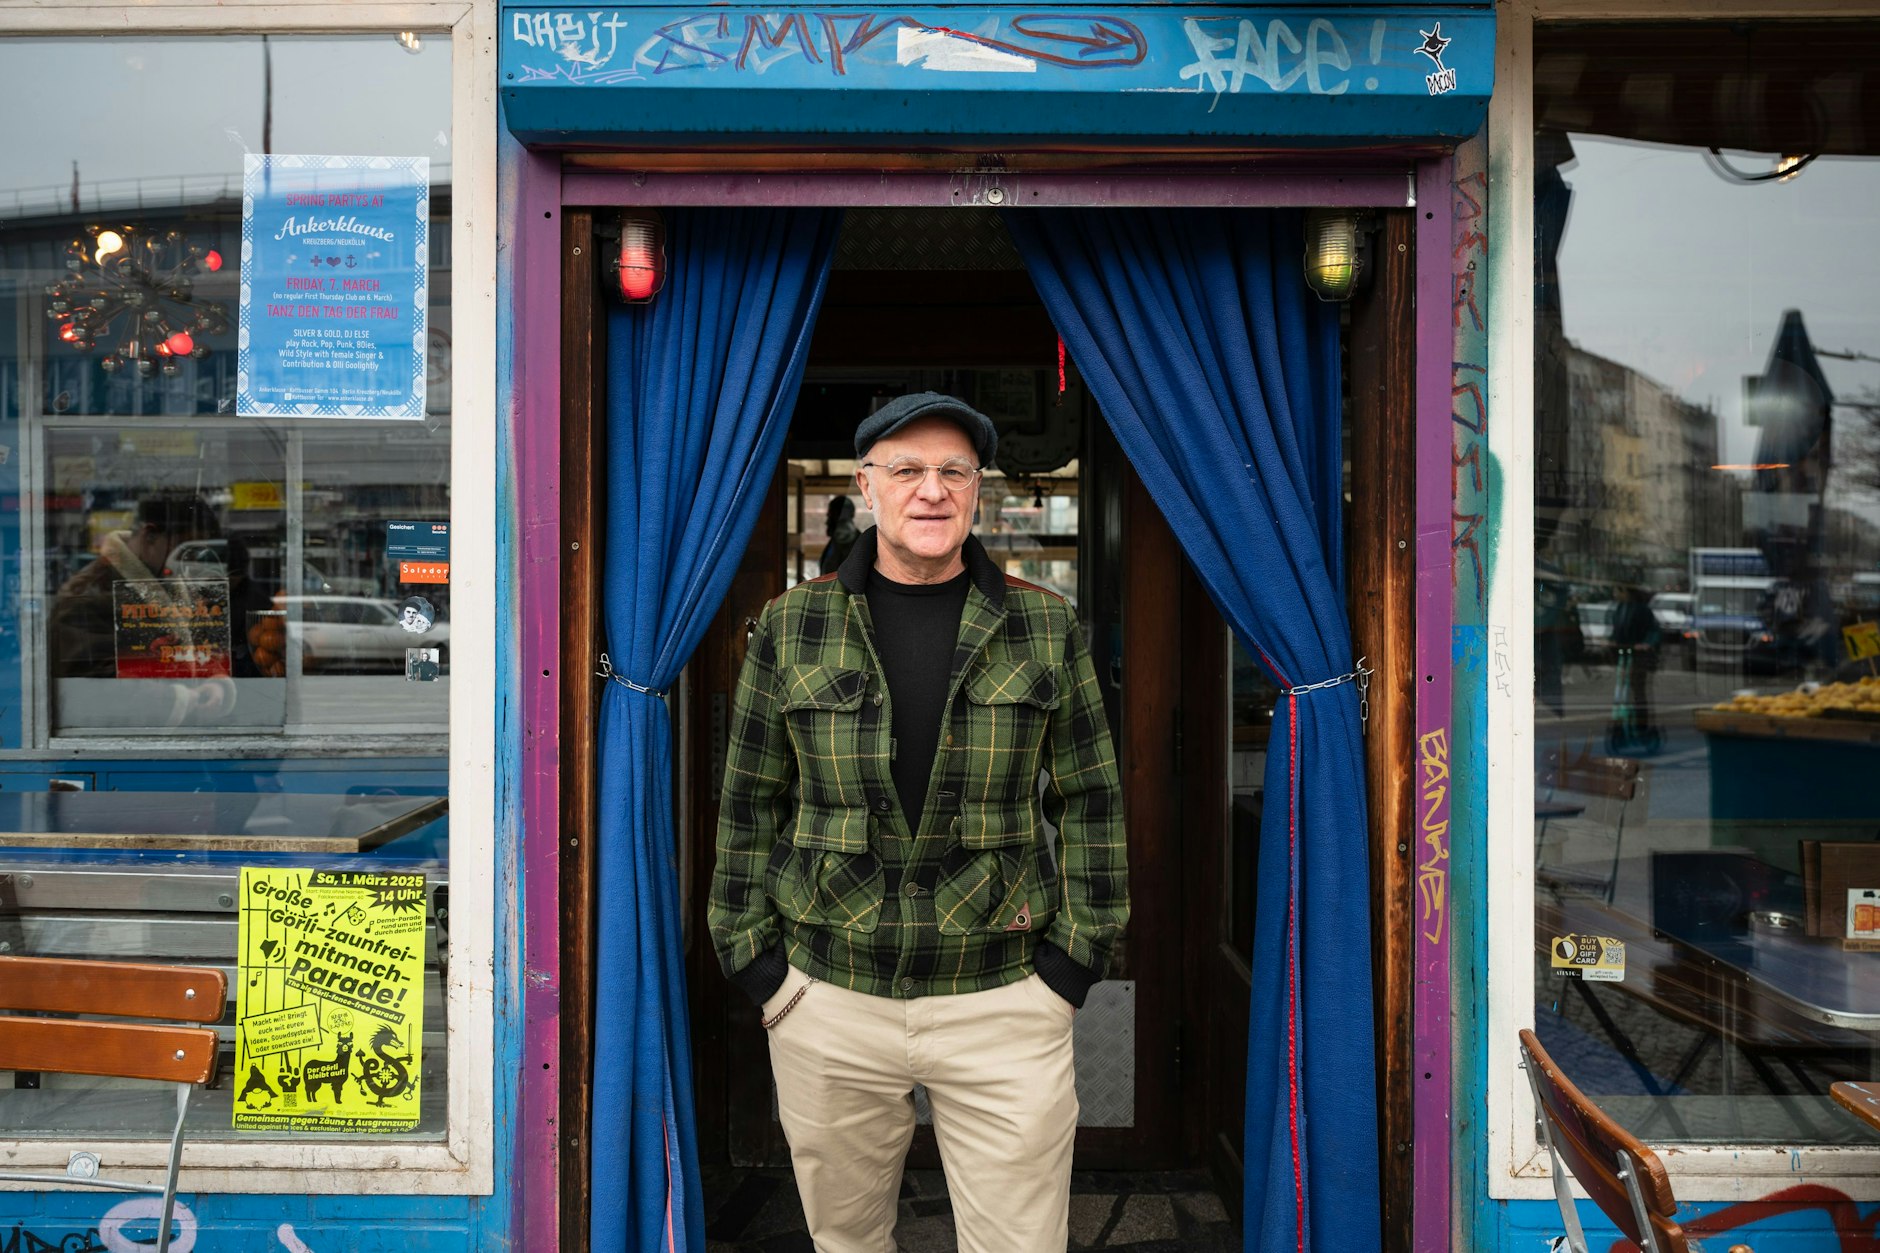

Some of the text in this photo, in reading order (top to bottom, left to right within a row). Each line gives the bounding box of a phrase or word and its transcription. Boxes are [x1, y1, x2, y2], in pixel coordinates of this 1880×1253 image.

[286, 193, 385, 208] SPRING PARTYS AT
[274, 215, 395, 242] Ankerklause
[303, 238, 366, 246] KREUZBERG/NEUKÖLLN
[287, 277, 380, 292] FRIDAY, 7. MARCH
[273, 292, 283, 300] (no
[284, 292, 303, 301] regular
[320, 293, 344, 302] Thursday
[374, 294, 393, 302] March)
[266, 304, 398, 320] TANZ DEN TAG DER FRAU
[294, 329, 370, 339] SILVER & GOLD, DJ ELSE
[286, 340, 377, 350] play Rock, Pop, Punk, 80ies,
[279, 350, 384, 361] Wild Style with female Singer &
[282, 360, 324, 369] Contribution
[325, 361, 332, 369] &
[345, 361, 379, 371] Goolightly
[316, 873, 424, 888] Sa, 1. März 2025
[252, 880, 313, 909] Große
[380, 888, 423, 902] 14 Uhr
[377, 915, 421, 924] Demo-Parade
[269, 908, 417, 962] Görli-zaunfrei-
[294, 939, 411, 983] mitmach-
[290, 957, 408, 1009] Parade!
[287, 979, 402, 1023] The big Görli-fence-free parade!
[252, 1011, 308, 1027] Macht mit! Bringt
[258, 1021, 305, 1035] euch mit euren
[271, 1027, 316, 1041] Soundsystems
[271, 1039, 301, 1050] sonstwas
[303, 1035, 314, 1044] ein!
[308, 1068, 346, 1080] bleibt auf!
[320, 1063, 339, 1073] Görli
[236, 1114, 419, 1129] Gemeinsam gegen Zäune & Ausgrenzung!
[236, 1122, 257, 1130] United
[257, 1123, 282, 1131] against
[310, 1124, 341, 1132] exclusion!
